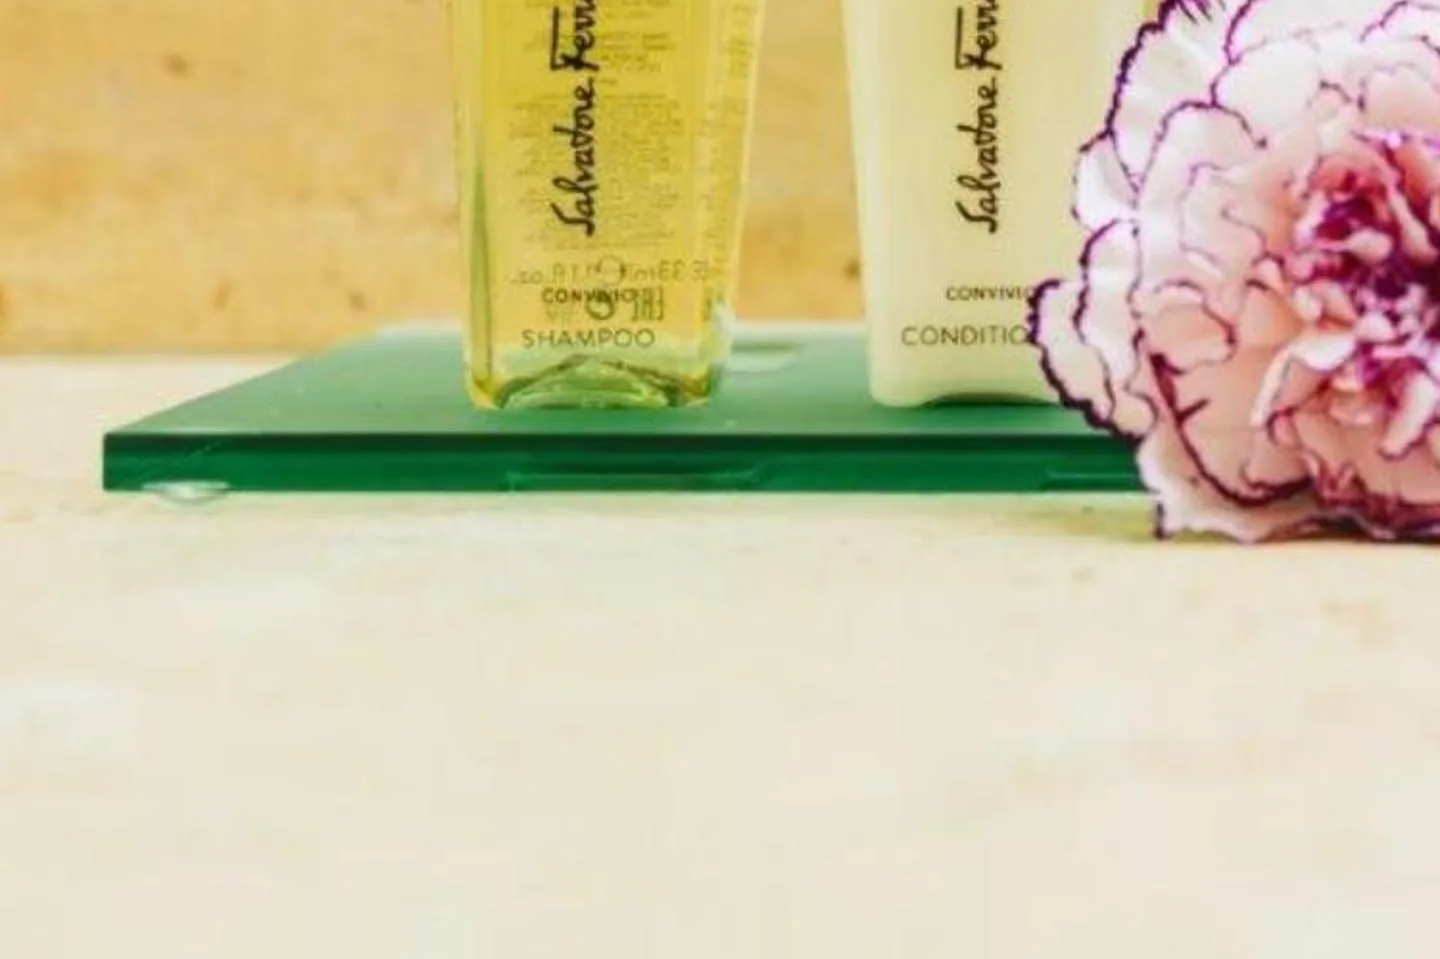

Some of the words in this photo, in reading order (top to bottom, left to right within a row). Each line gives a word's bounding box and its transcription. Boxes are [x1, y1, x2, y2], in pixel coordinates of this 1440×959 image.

[550, 78, 598, 237] Salvatore
[956, 78, 1001, 234] Salvatore
[521, 328, 656, 349] SHAMPOO
[901, 325, 1028, 346] CONDITIO
